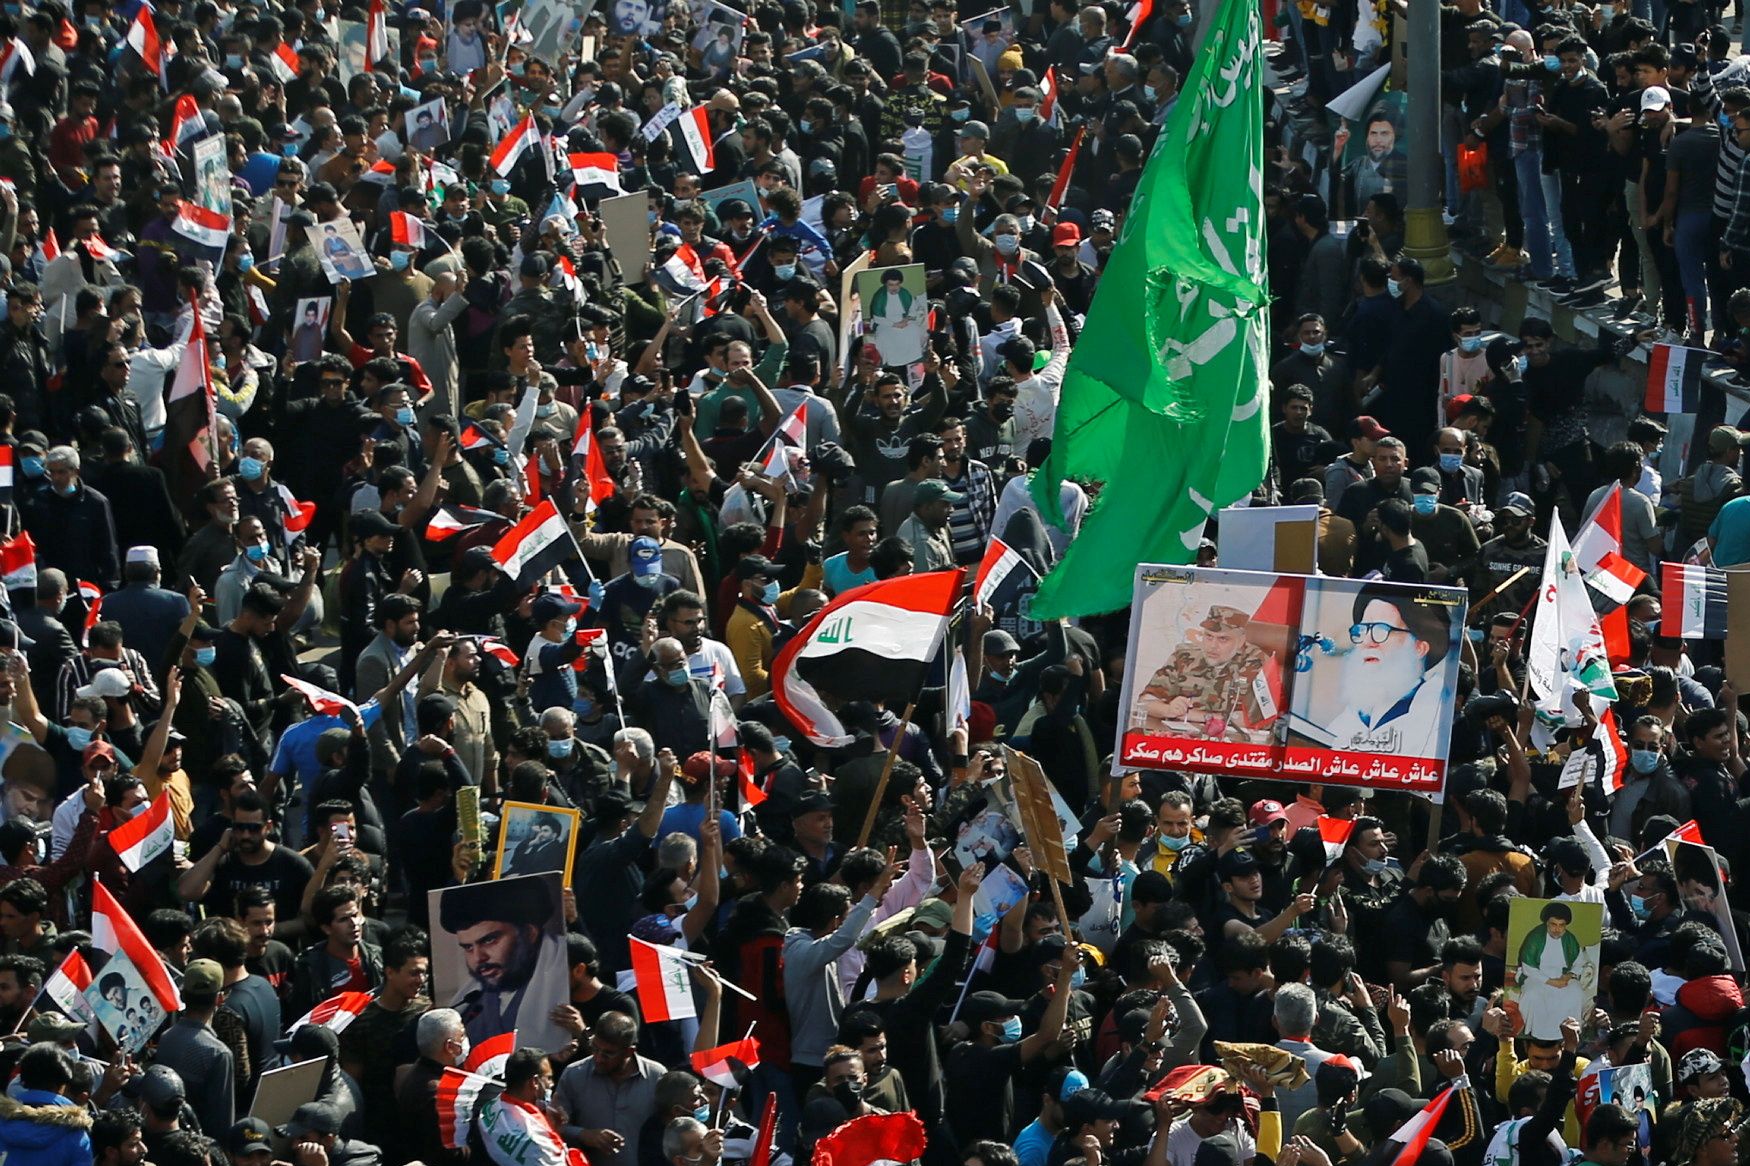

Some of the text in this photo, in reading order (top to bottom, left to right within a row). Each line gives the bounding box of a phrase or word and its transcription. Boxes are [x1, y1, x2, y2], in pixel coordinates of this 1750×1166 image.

[1123, 738, 1159, 761] صكر
[1225, 748, 1274, 768] مقتدى
[1273, 756, 1321, 775] الصدر
[1322, 758, 1359, 778] عاش
[1362, 761, 1399, 781] عاش
[1402, 764, 1439, 783] عاش
